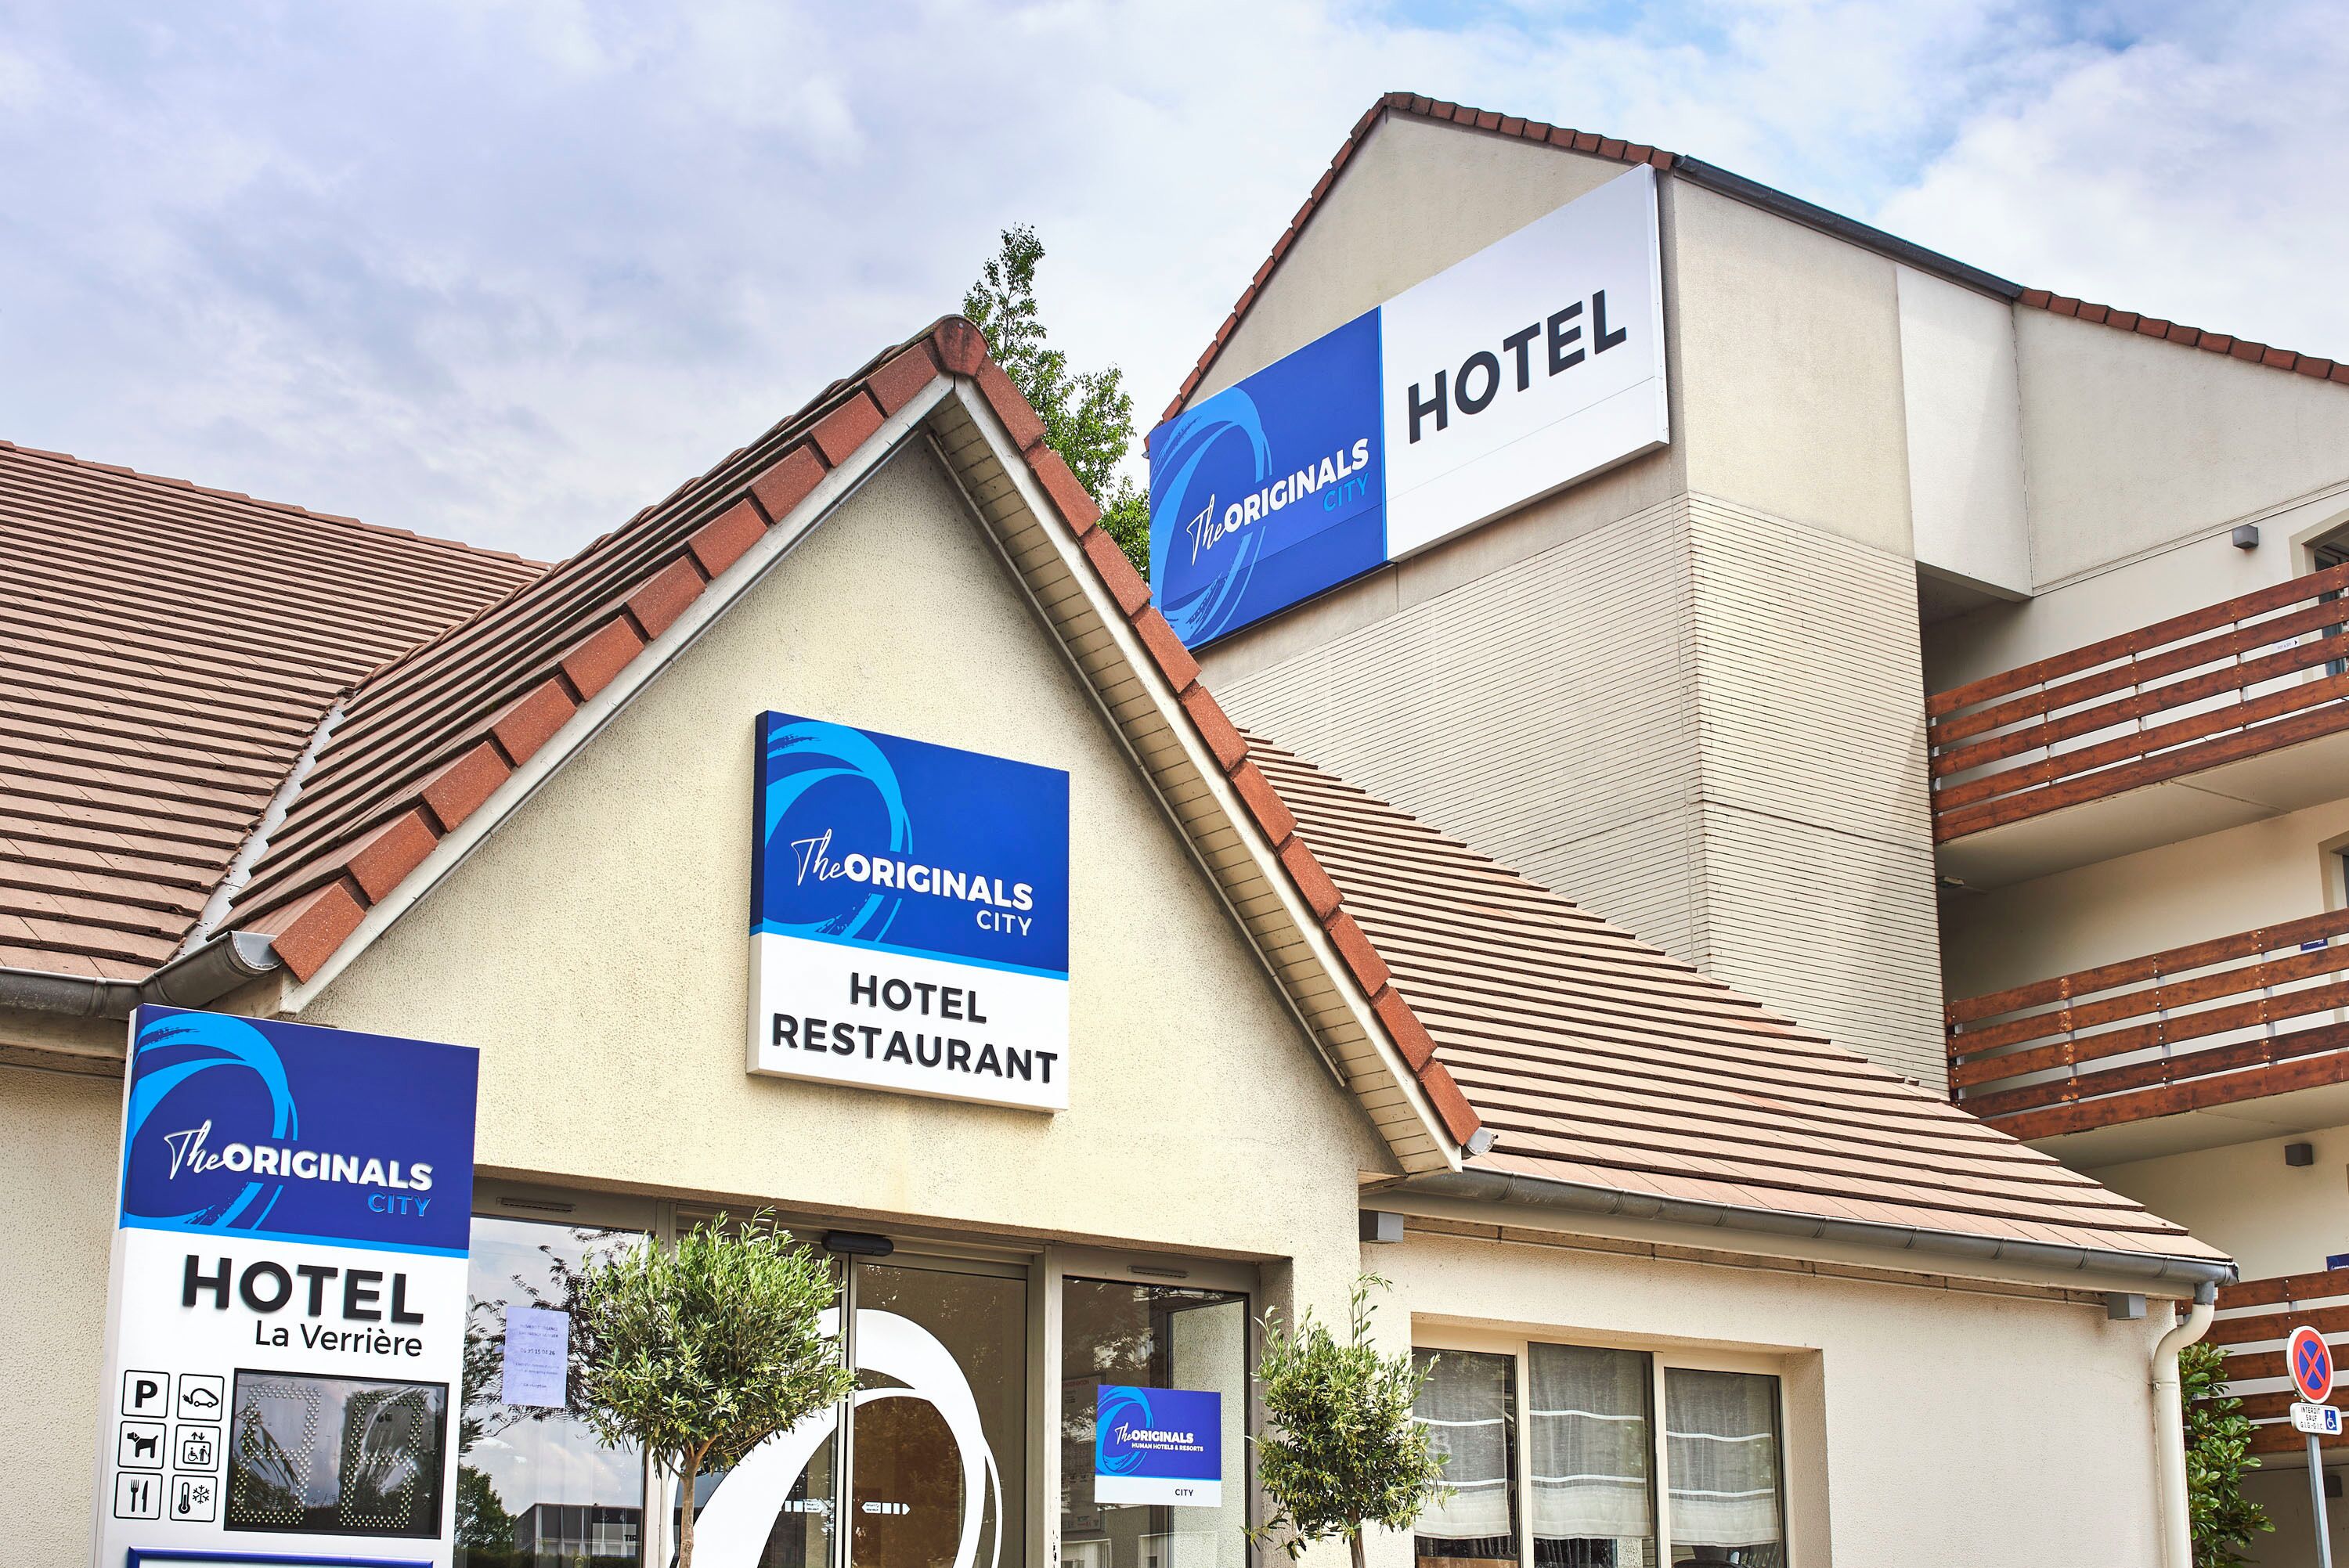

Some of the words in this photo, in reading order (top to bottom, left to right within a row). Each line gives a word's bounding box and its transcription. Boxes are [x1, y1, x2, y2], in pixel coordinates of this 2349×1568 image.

[1407, 289, 1627, 445] HOTEL
[1186, 493, 1225, 566] The
[1223, 438, 1369, 533] ORIGINALS
[1322, 473, 1369, 513] CITY
[791, 828, 847, 886] The
[844, 853, 1034, 911] ORIGINALS
[976, 910, 1033, 936] CITY
[850, 972, 987, 1023] HOTEL
[772, 1012, 1058, 1083] RESTAURANT
[164, 1119, 226, 1181] The
[222, 1144, 434, 1191] ORIGINALS
[367, 1191, 431, 1217] CITY
[182, 1255, 424, 1324] HOTEL
[255, 1319, 290, 1348] La
[300, 1323, 423, 1357] Verrière
[135, 1380, 158, 1408] P
[2300, 1406, 2320, 1415] INTERDIT
[1114, 1422, 1132, 1445] The
[1131, 1429, 1194, 1444] ORIGINALS
[1174, 1488, 1194, 1497] CITY
